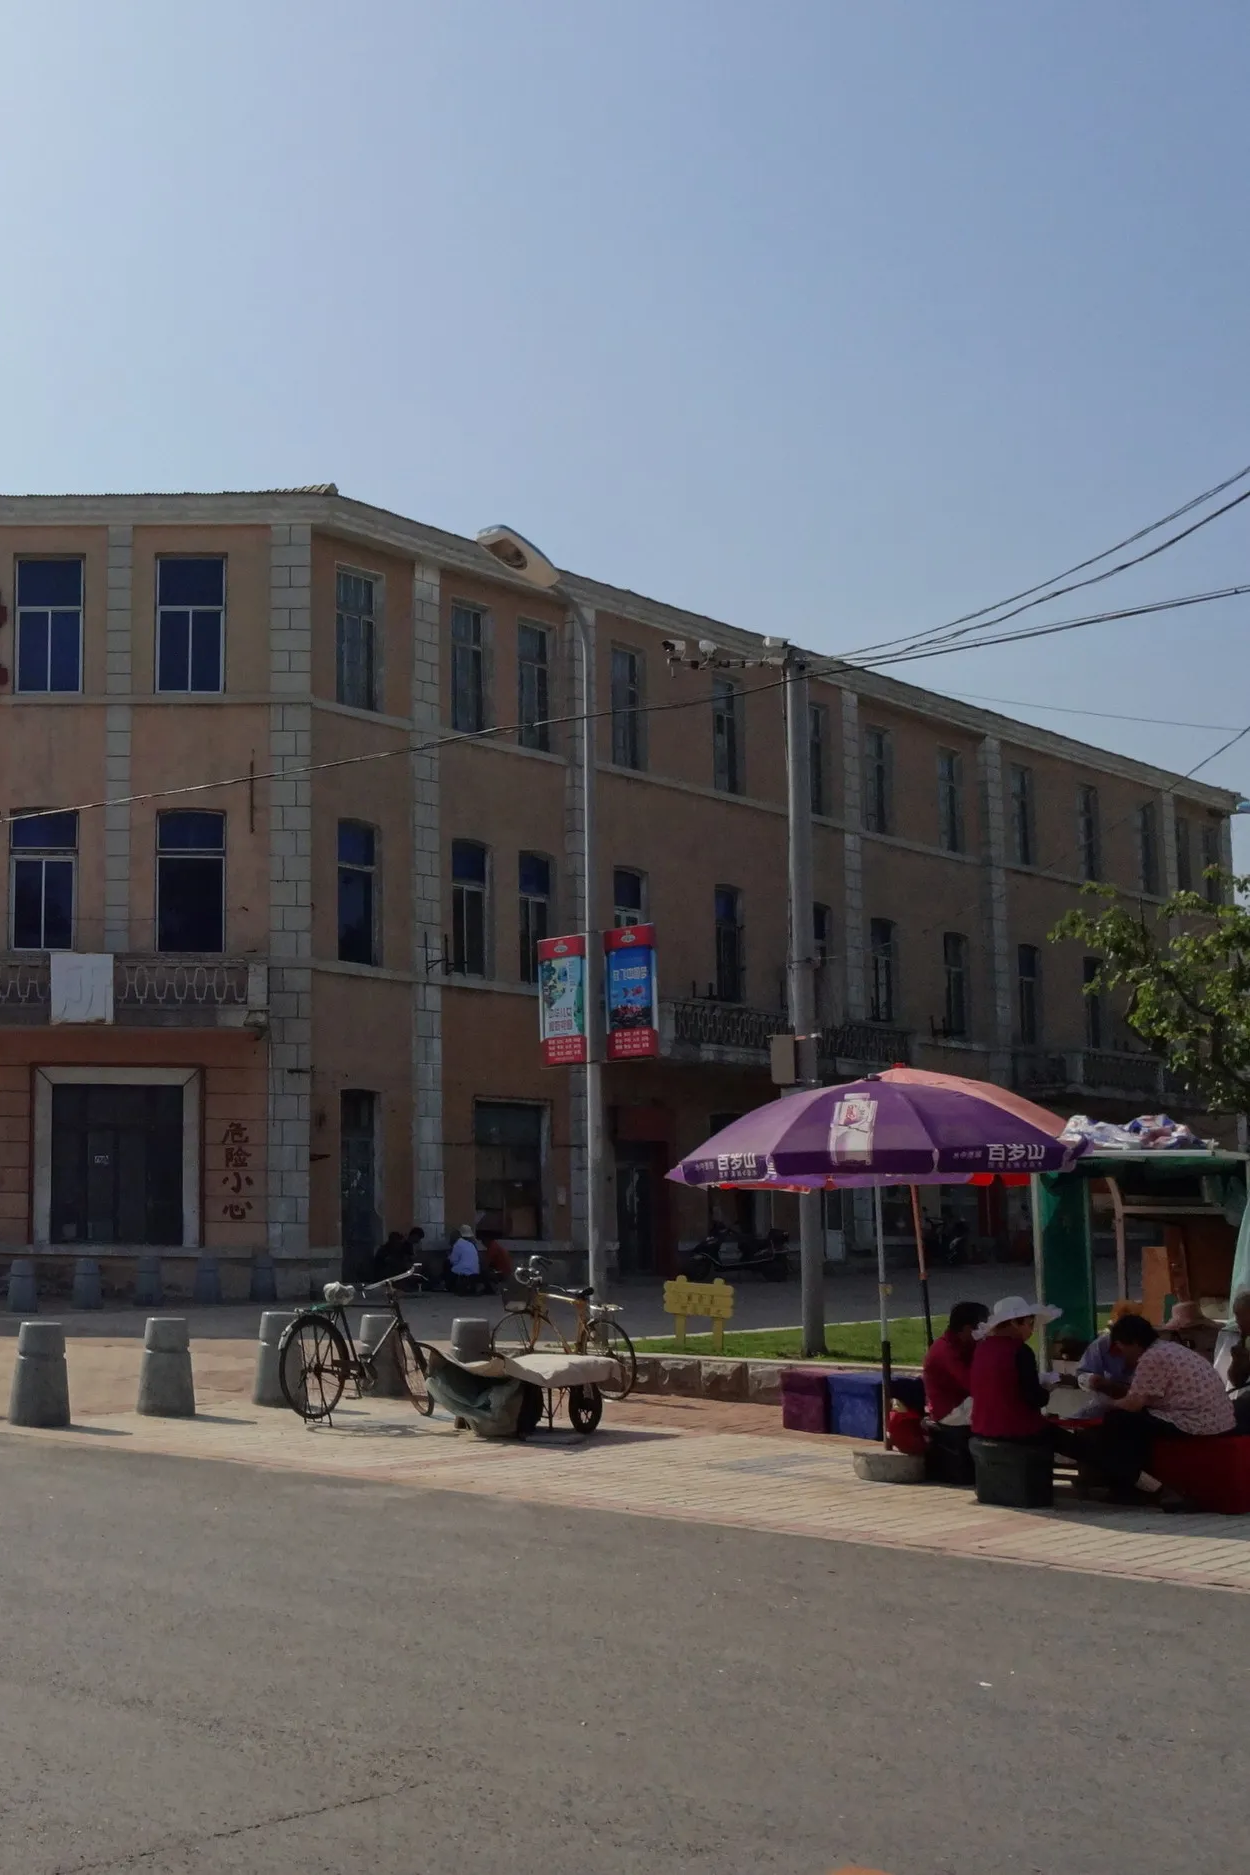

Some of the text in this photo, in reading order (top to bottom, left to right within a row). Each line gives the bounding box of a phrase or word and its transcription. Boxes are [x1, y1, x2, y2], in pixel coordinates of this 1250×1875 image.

[717, 1152, 757, 1171] 百岁山
[986, 1143, 1046, 1161] 百岁山
[222, 1122, 254, 1220] 危险小心
